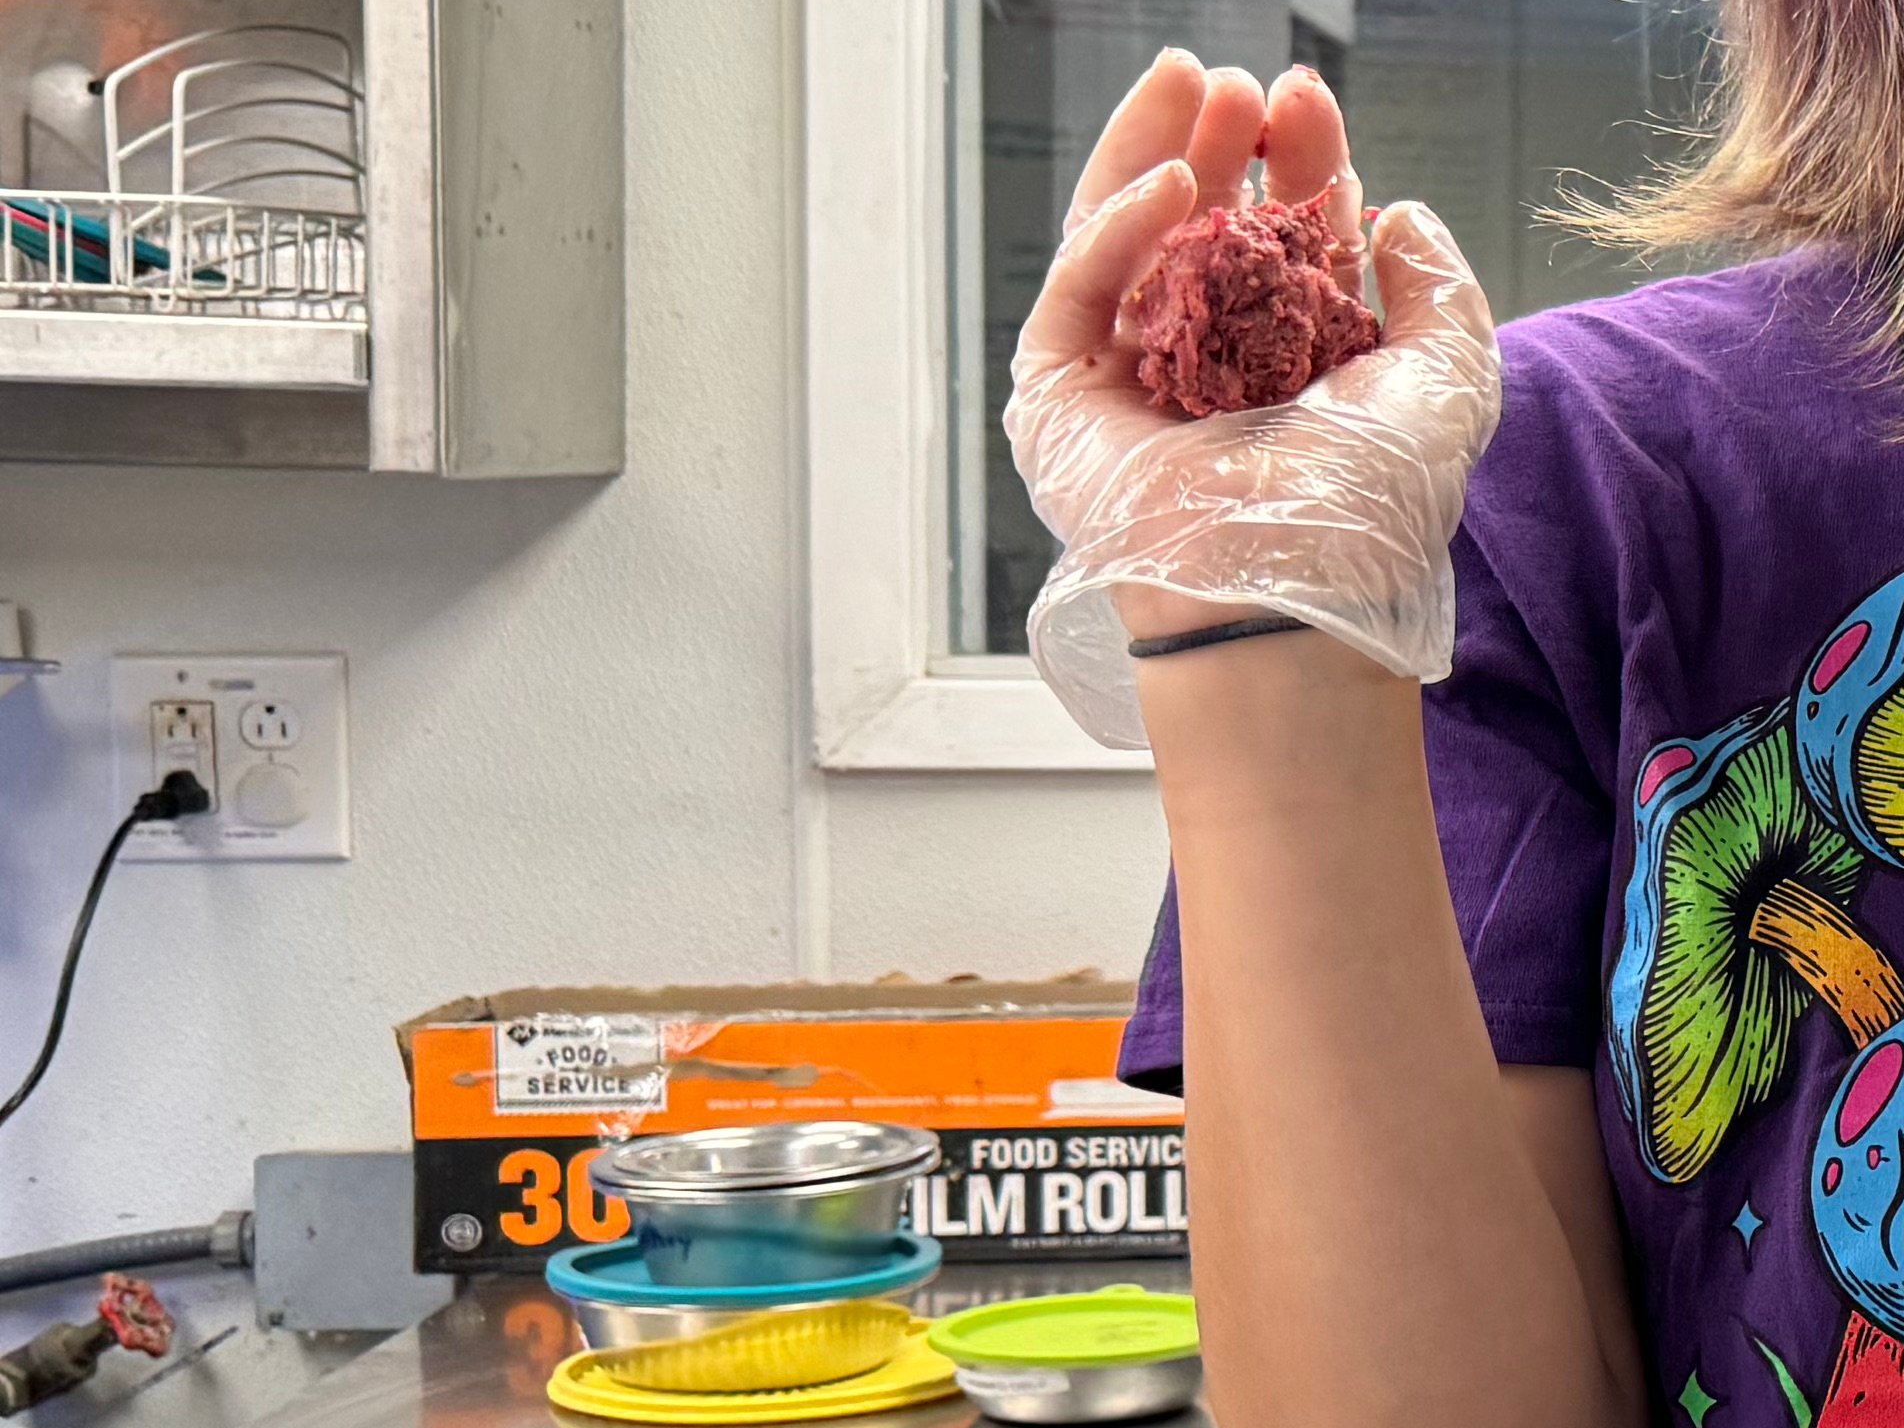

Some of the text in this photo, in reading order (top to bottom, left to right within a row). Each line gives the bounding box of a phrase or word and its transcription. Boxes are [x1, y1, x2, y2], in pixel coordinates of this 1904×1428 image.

[545, 1044, 610, 1069] FOOD
[971, 1134, 1184, 1170] FOOD SERVIC
[912, 1172, 1026, 1237] ILM
